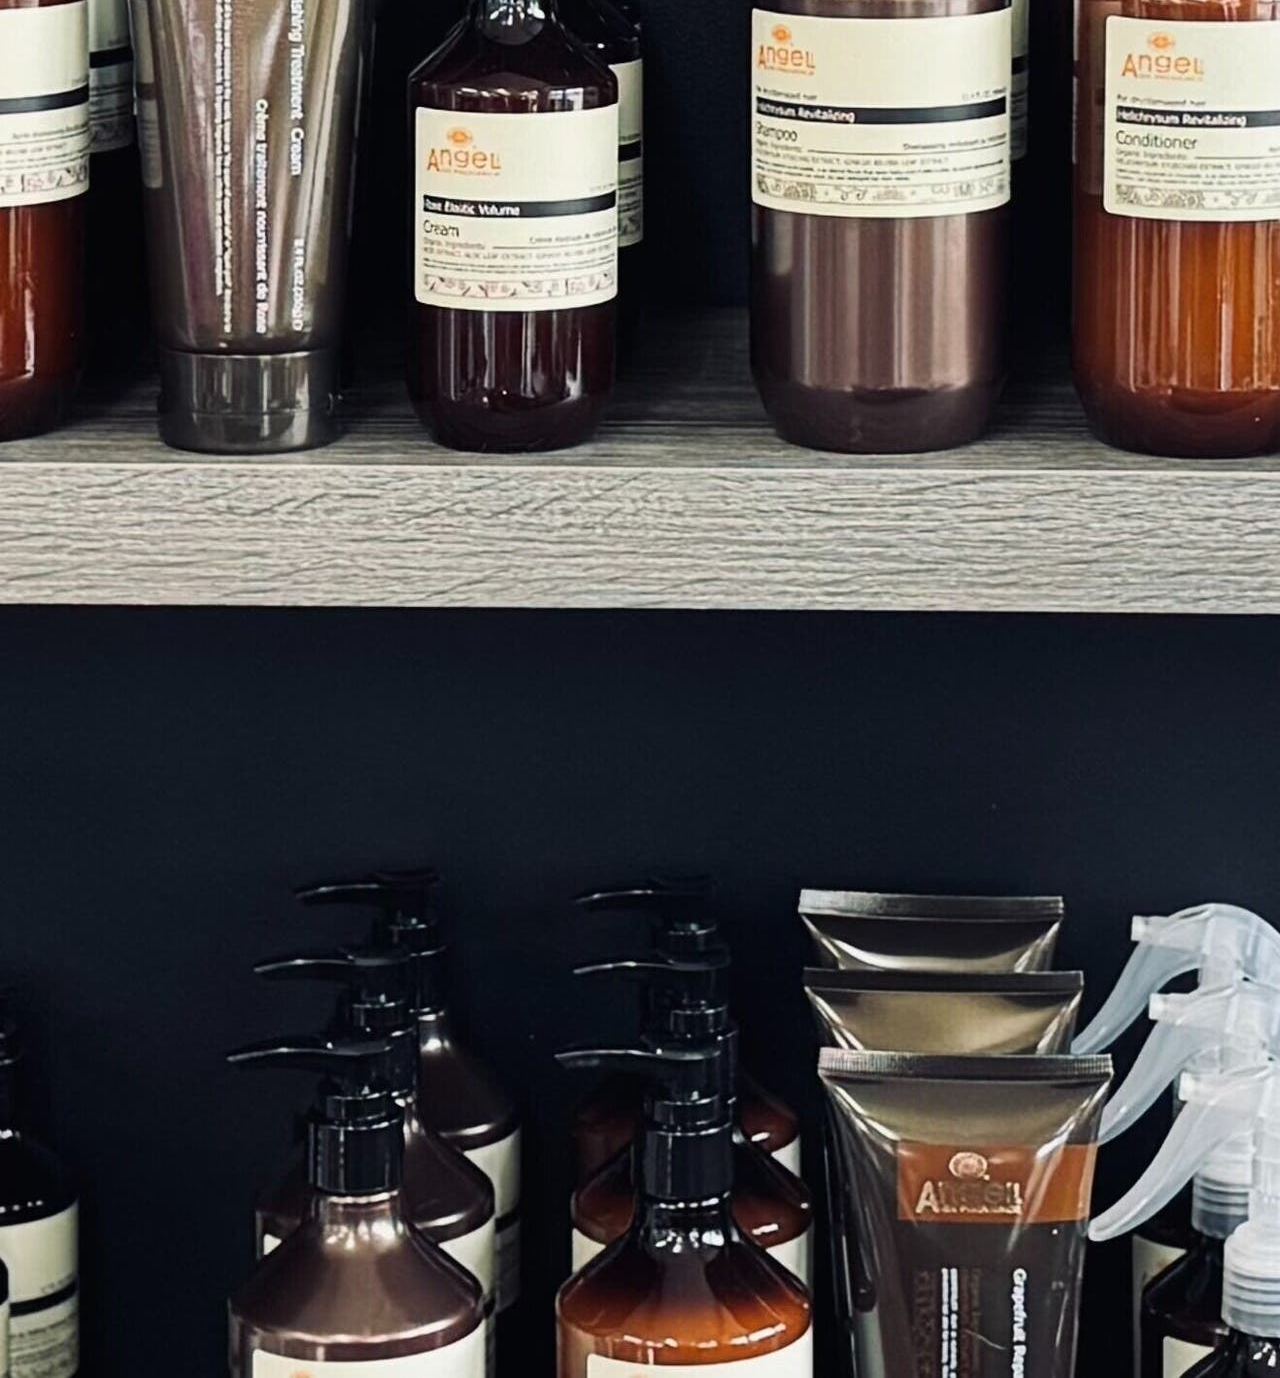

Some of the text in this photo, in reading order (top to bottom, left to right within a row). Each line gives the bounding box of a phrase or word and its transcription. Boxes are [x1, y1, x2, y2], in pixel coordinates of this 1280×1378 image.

[290, 45, 305, 120] Treatment
[798, 106, 855, 124] Revitalizing
[1182, 112, 1247, 128] Revitalizing
[1115, 129, 1198, 150] Conditioner
[290, 127, 305, 176] Cream
[444, 200, 475, 215] Elastic
[478, 203, 520, 217] Volume
[423, 220, 460, 238] Cream
[256, 282, 269, 300] de
[1012, 1268, 1028, 1342] Grapefruit
